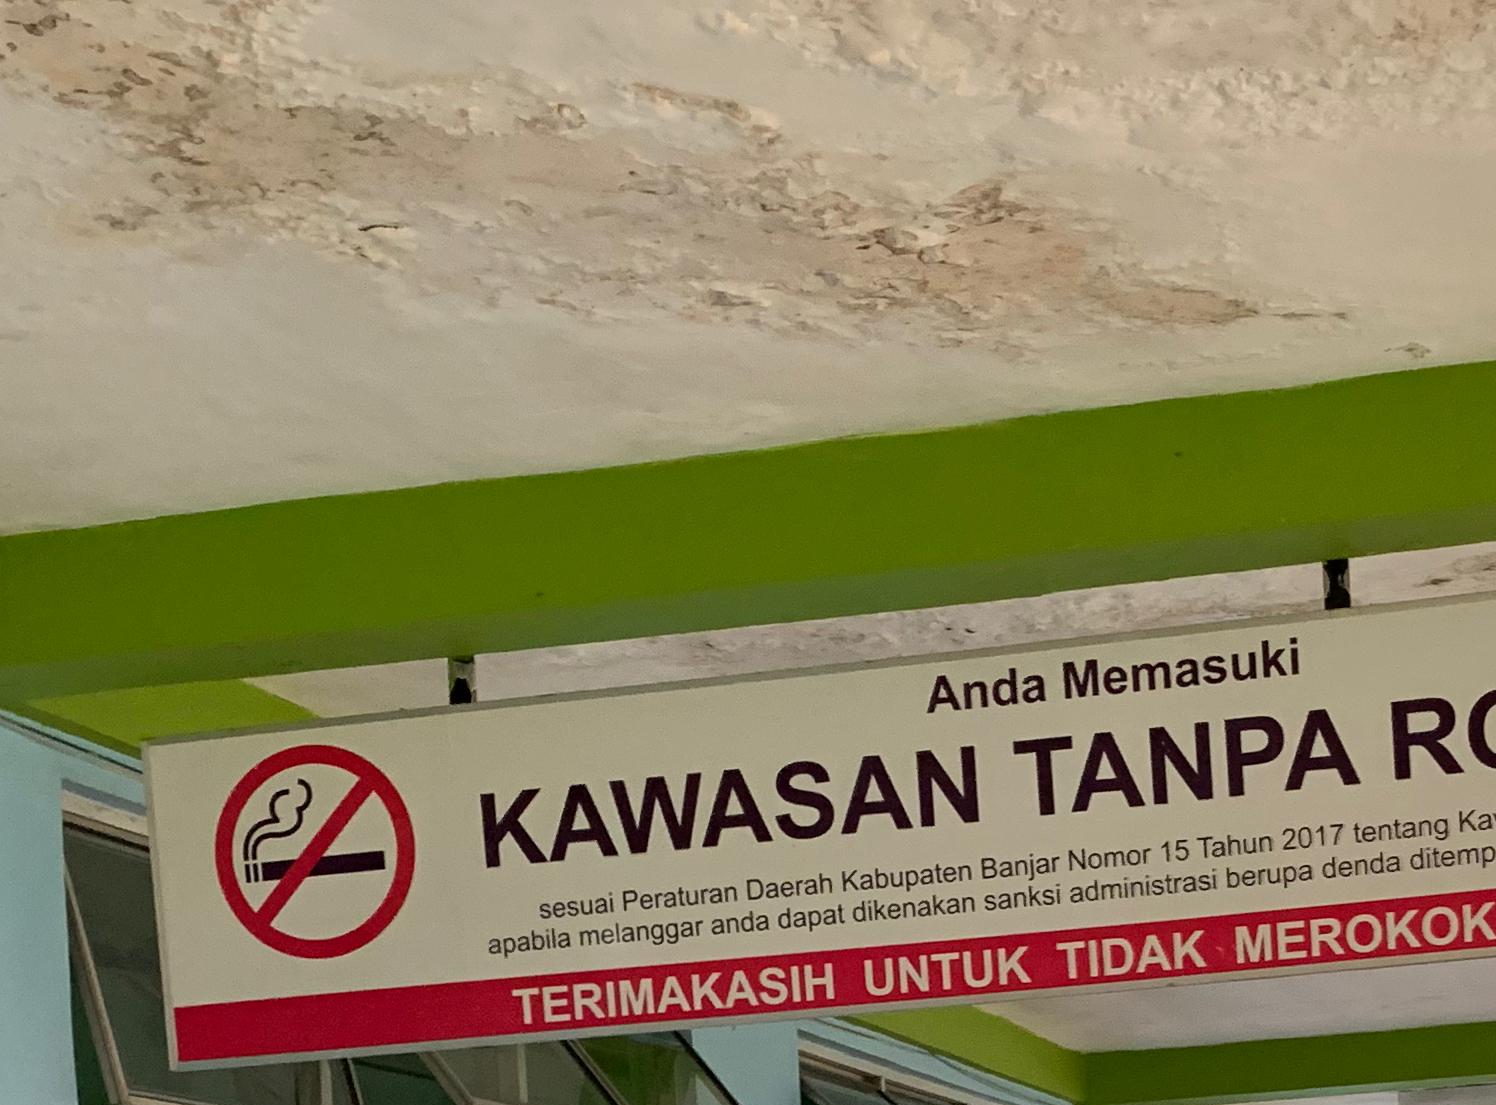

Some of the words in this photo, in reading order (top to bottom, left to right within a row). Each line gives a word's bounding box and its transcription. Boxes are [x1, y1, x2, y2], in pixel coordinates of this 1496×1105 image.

[927, 668, 1046, 713] Anda
[1063, 637, 1299, 699] Memasuki
[480, 746, 979, 868] KAWASAN
[1013, 709, 1360, 815] TANPA
[489, 928, 571, 958] apabila
[579, 920, 703, 946] melanggar
[712, 911, 769, 935] anda
[778, 904, 845, 932] dapat
[853, 895, 975, 922] dikenakan
[984, 884, 1060, 911] sanksi
[1070, 869, 1217, 903] administrasi
[1226, 865, 1312, 888] berupa
[1322, 852, 1400, 878] denda
[540, 892, 614, 919] sesuai
[623, 886, 737, 911] Peraturan
[747, 873, 832, 900] Daerah
[842, 864, 972, 892] Kabupaten
[981, 854, 1060, 881] Banjar
[1068, 848, 1151, 871] Nomor
[1161, 840, 1189, 862] 15
[1197, 835, 1272, 858] Tahun
[1282, 824, 1343, 850] 2017
[1353, 819, 1449, 843] tentang
[512, 963, 834, 1024] TERIMAKASIH
[864, 946, 1031, 995] UNTUK
[1056, 930, 1207, 978] TIDAK
[1235, 902, 1496, 963] MEROKOK
